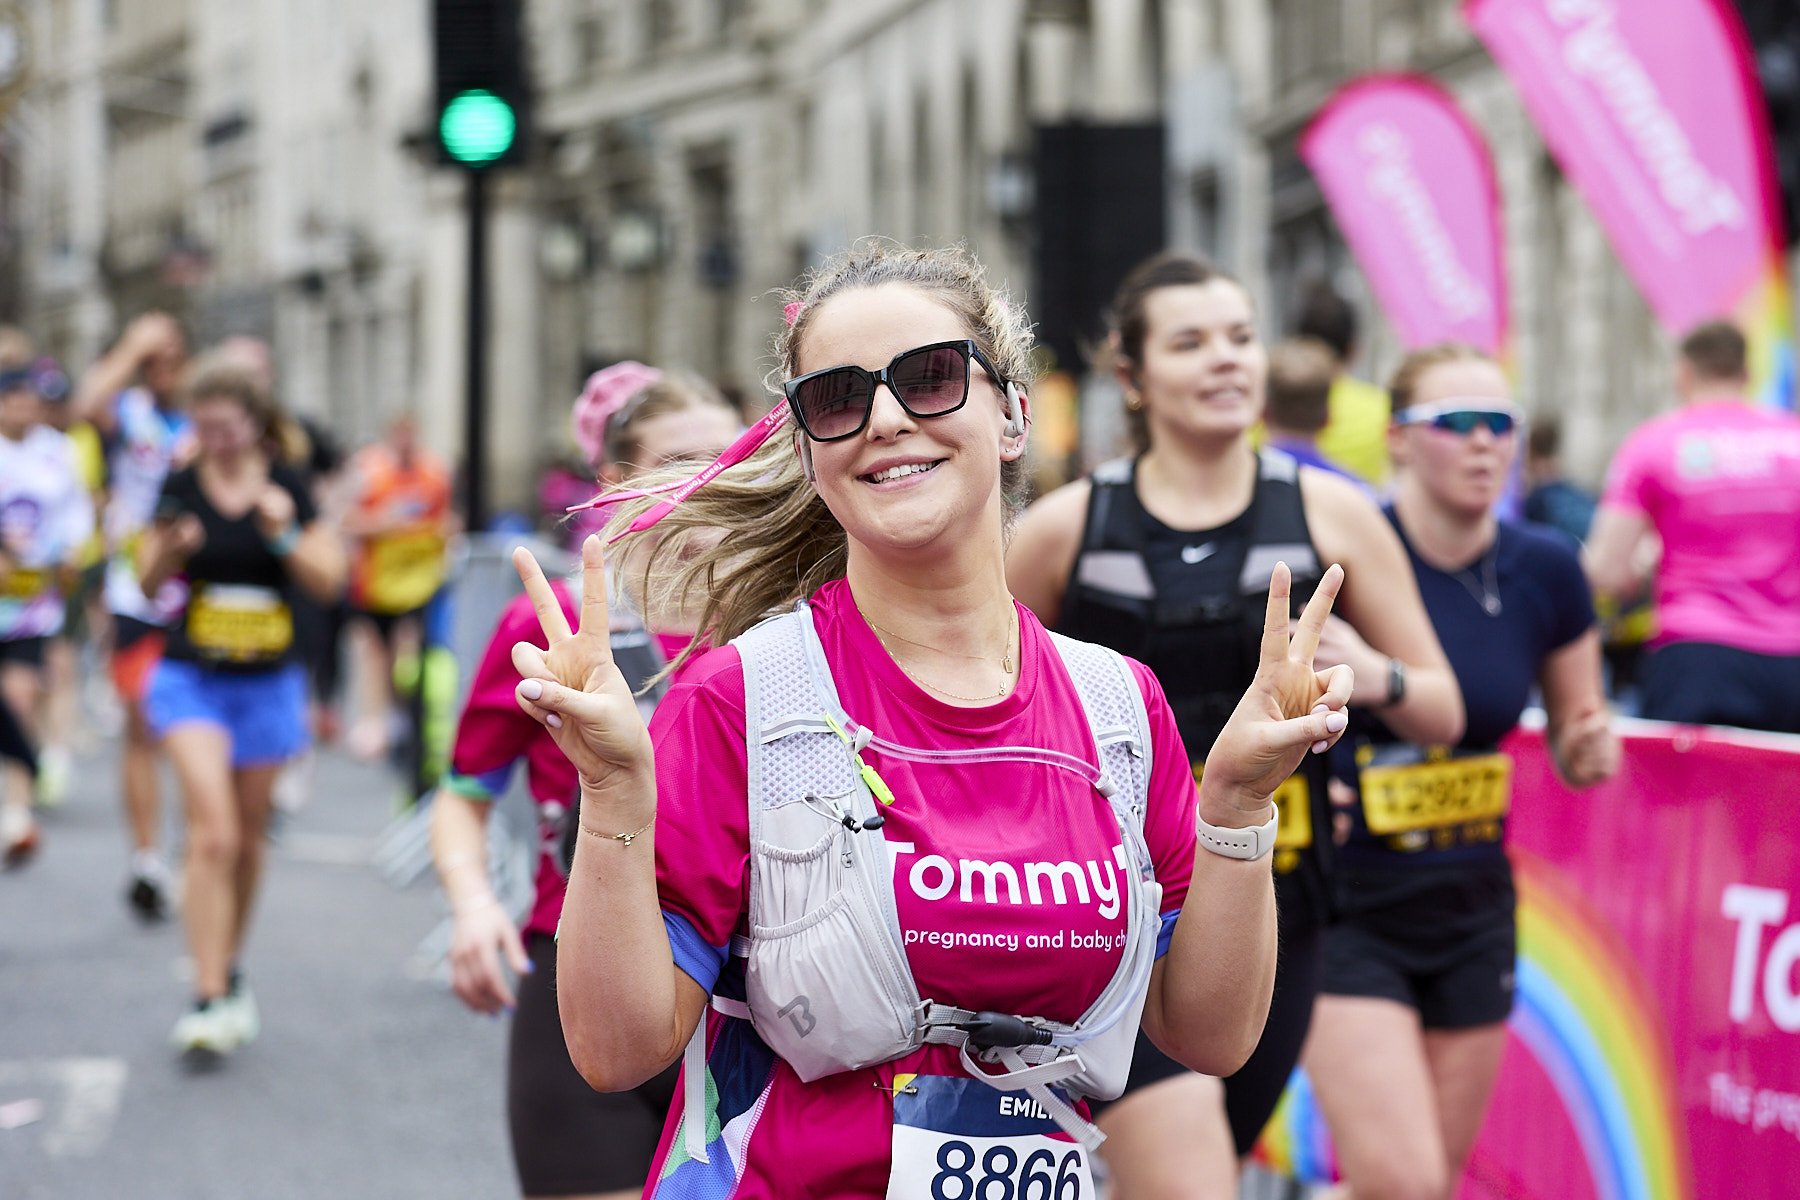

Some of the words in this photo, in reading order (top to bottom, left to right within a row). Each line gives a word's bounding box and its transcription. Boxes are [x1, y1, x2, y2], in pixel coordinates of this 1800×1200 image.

[701, 461, 725, 480] Team
[904, 929, 1019, 952] pregnancy
[1025, 930, 1063, 949] and
[1070, 930, 1113, 952] baby
[1000, 1095, 1053, 1120] EMIL
[931, 1140, 1081, 1200] 8866
